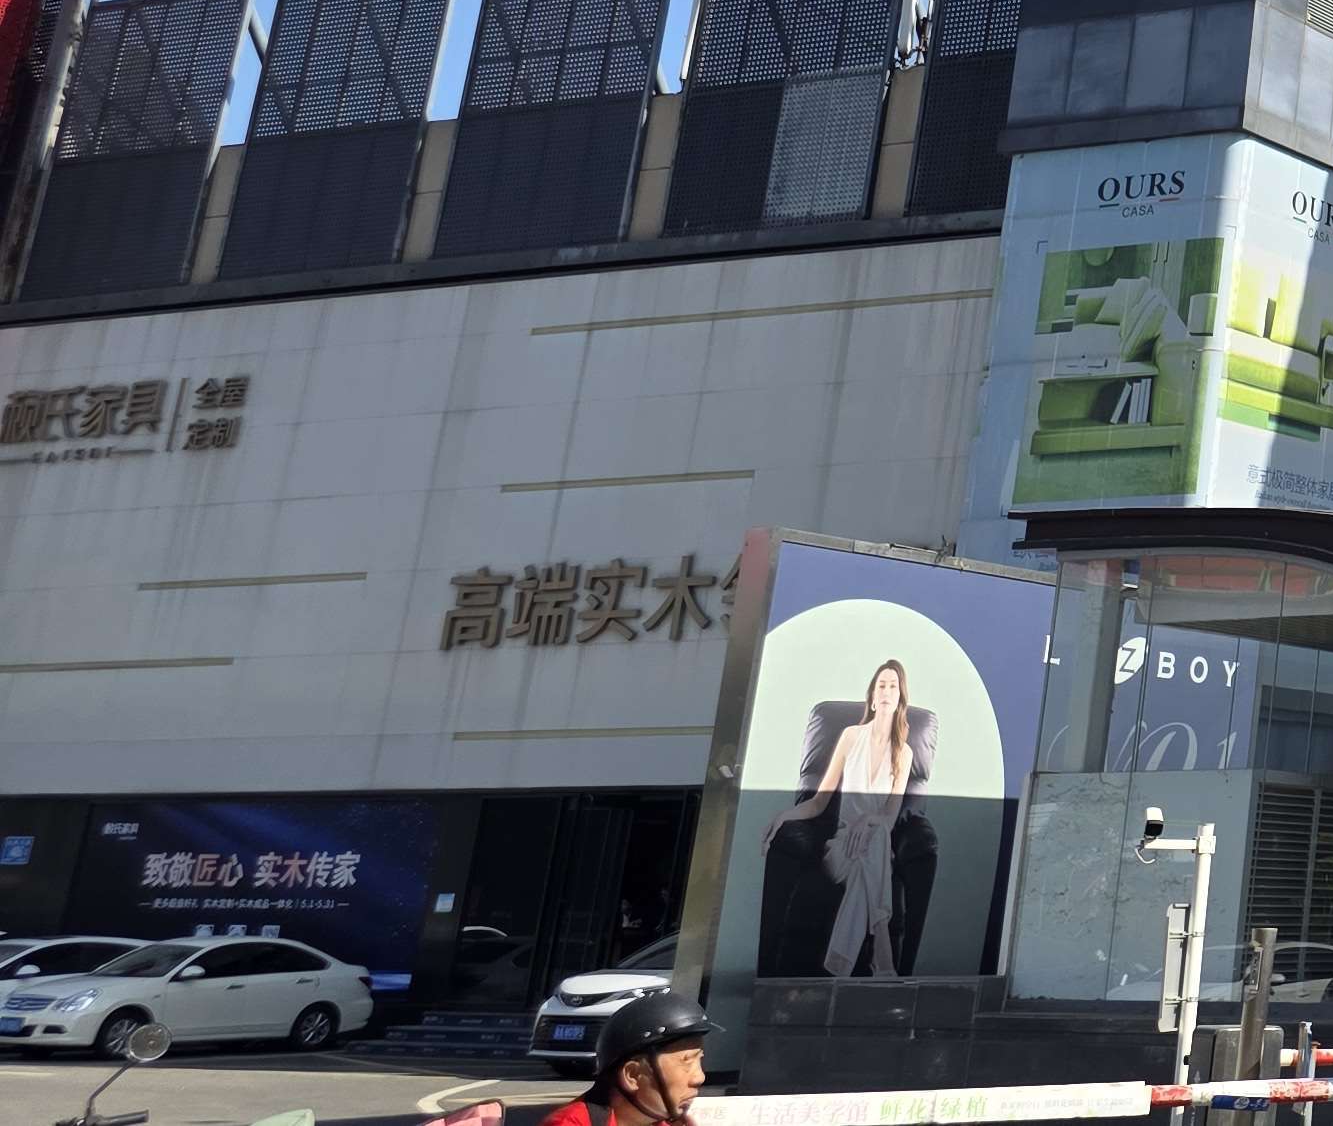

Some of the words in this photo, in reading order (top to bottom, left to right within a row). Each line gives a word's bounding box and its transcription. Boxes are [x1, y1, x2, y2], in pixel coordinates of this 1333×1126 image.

[1097, 170, 1186, 202] OURS
[1122, 204, 1155, 219] CASA
[1307, 226, 1331, 245] CASA
[192, 377, 250, 409] 全屋
[182, 417, 243, 450] 定制
[141, 851, 244, 889] 致敬匠心
[253, 850, 361, 889] 实木传家
